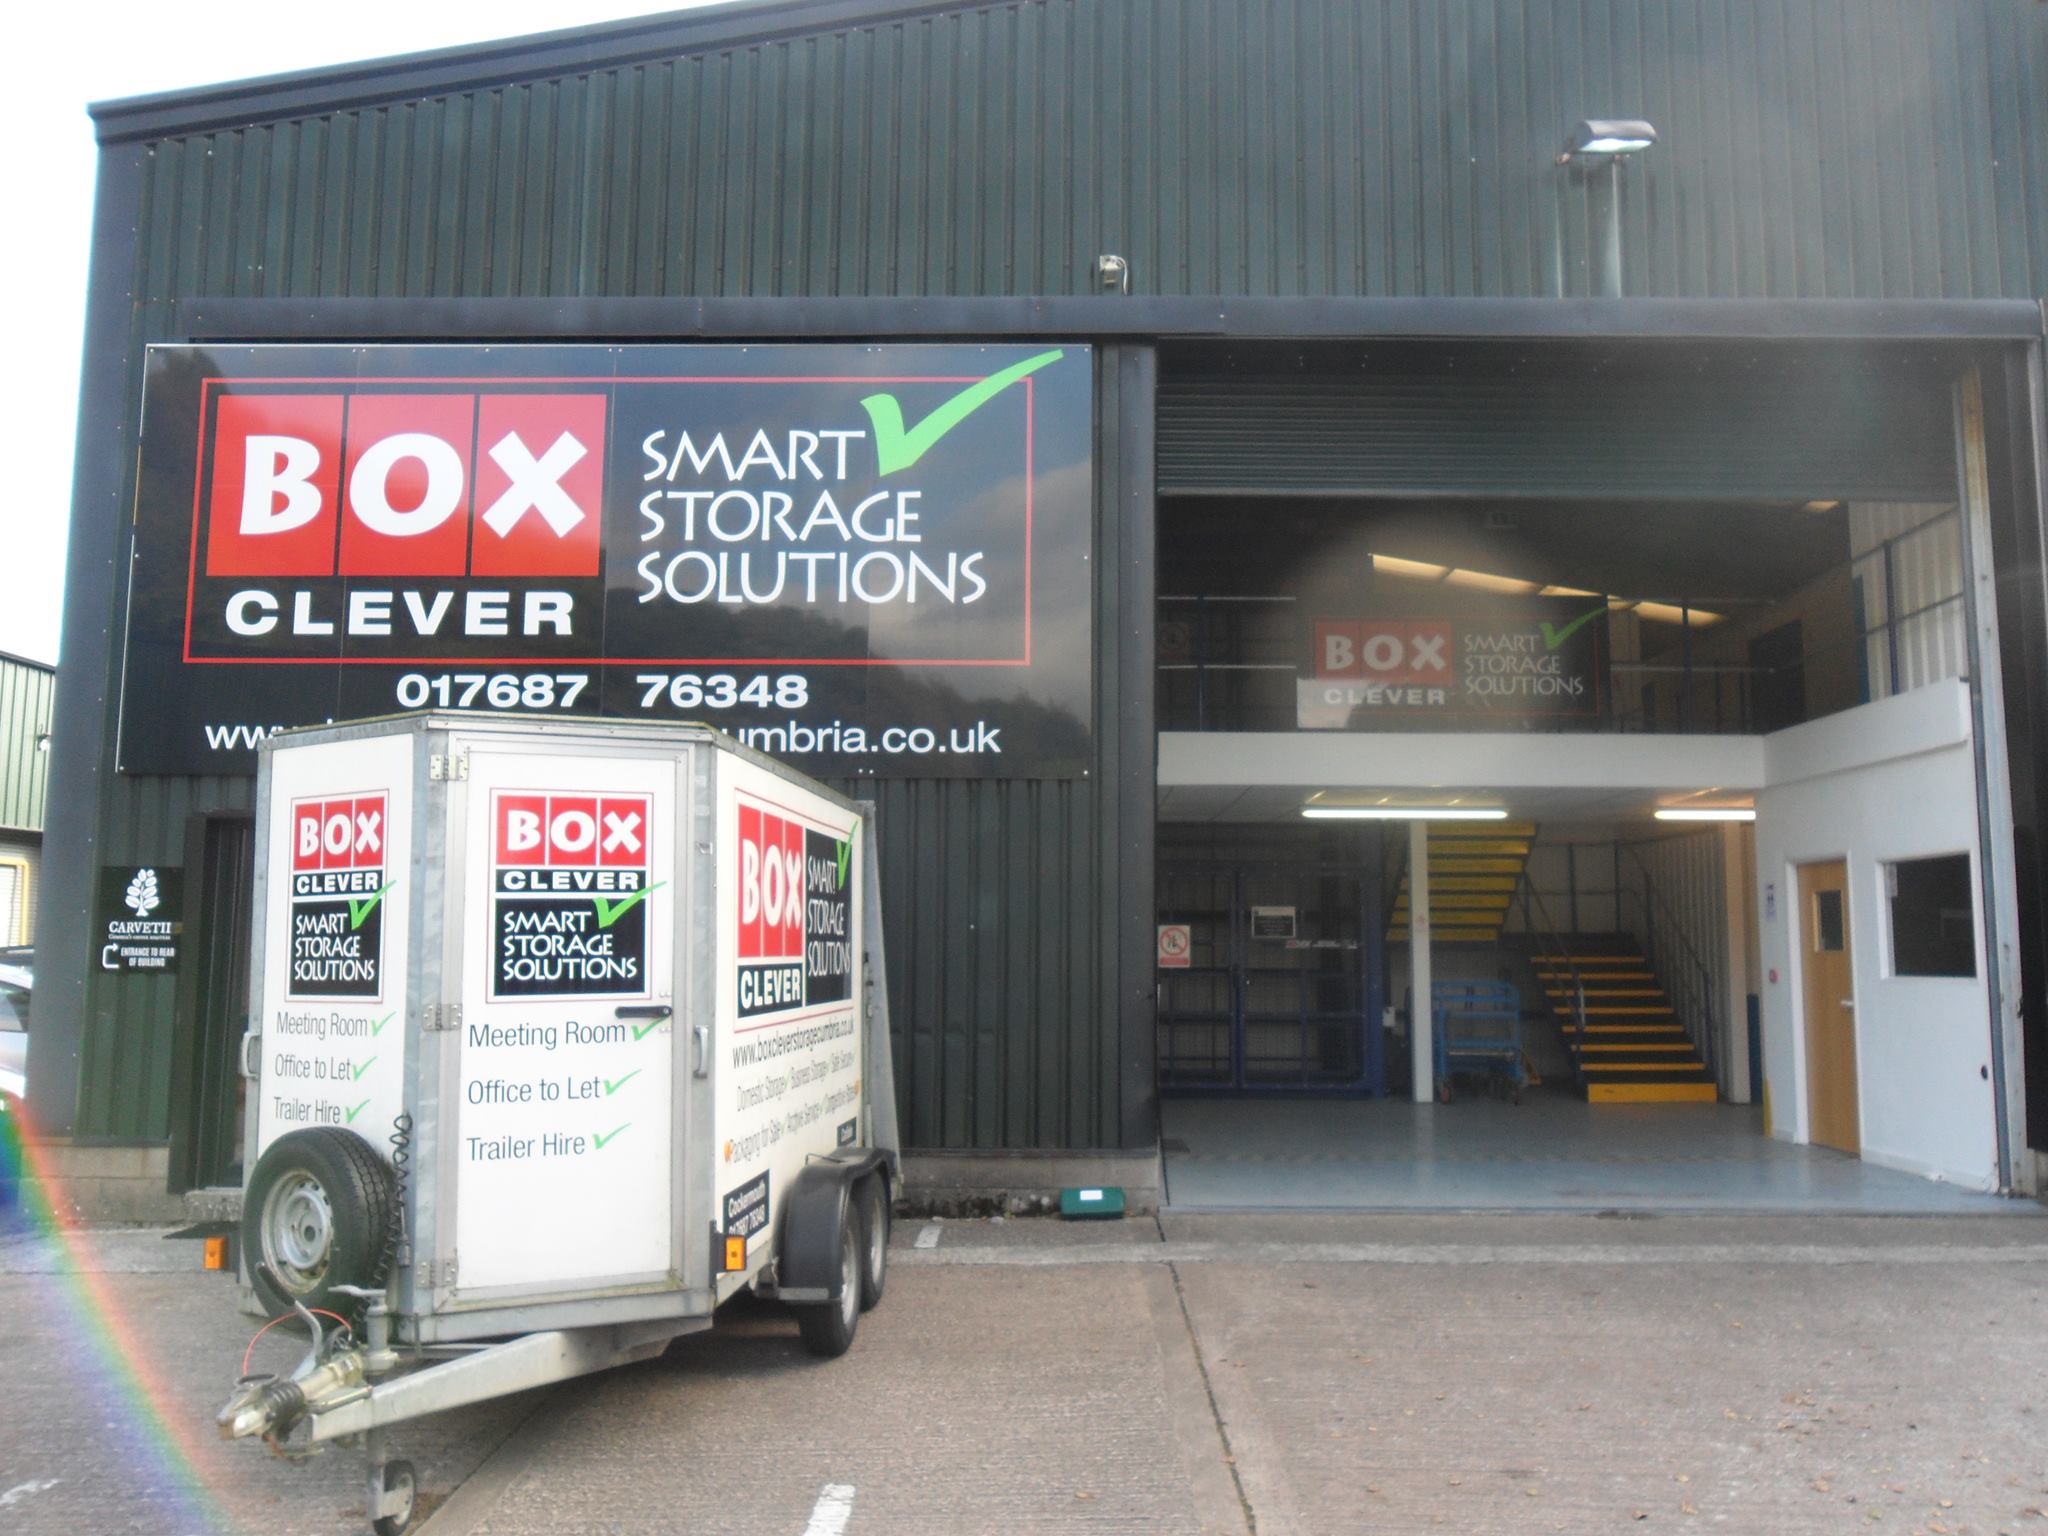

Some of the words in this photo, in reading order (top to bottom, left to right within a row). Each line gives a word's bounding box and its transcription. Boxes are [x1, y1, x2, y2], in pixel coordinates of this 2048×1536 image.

[642, 428, 866, 482] SMART
[239, 430, 589, 538] BOX
[639, 489, 921, 542] STORAGE
[637, 550, 987, 604] SOLUTIONS
[225, 589, 575, 636] CLEVER
[1325, 633, 1446, 671] BOX
[1464, 634, 1540, 653] SMART
[1464, 655, 1561, 675] STORAGE
[396, 674, 588, 708] 017687
[636, 674, 809, 709] 76348
[1323, 688, 1446, 705] CLEVER
[1464, 676, 1584, 696] SOLUTIONS
[299, 810, 381, 857] BOX
[507, 809, 642, 854] BOX
[296, 870, 379, 894] CLEVER
[503, 870, 639, 891] CLEVER
[742, 838, 802, 929] BOX
[808, 855, 838, 895] SMART
[108, 921, 172, 934] CARVETII
[296, 912, 348, 935] SMART
[503, 911, 592, 934] SMART
[808, 899, 845, 936] STORAGE
[295, 936, 361, 959] STORAGE
[503, 934, 613, 957] STORAGE
[808, 941, 851, 977] SOLUTIONS
[294, 958, 375, 982] SOLUTIONS
[503, 957, 637, 981] SOLUTIONS
[740, 968, 801, 1010] CLEVER
[276, 1011, 326, 1040] Meeting
[329, 1013, 368, 1037] Room
[468, 1022, 558, 1051] Meeting
[565, 1021, 626, 1045] Room
[274, 1054, 312, 1080] Office
[314, 1057, 327, 1079] to
[330, 1055, 351, 1081] Let
[467, 1080, 532, 1105] Office
[539, 1078, 560, 1101] to
[567, 1075, 601, 1100] Let
[274, 1096, 312, 1123] Trailer
[315, 1099, 341, 1124] Hire
[466, 1135, 535, 1162] Trailer
[543, 1134, 585, 1157] Hire
